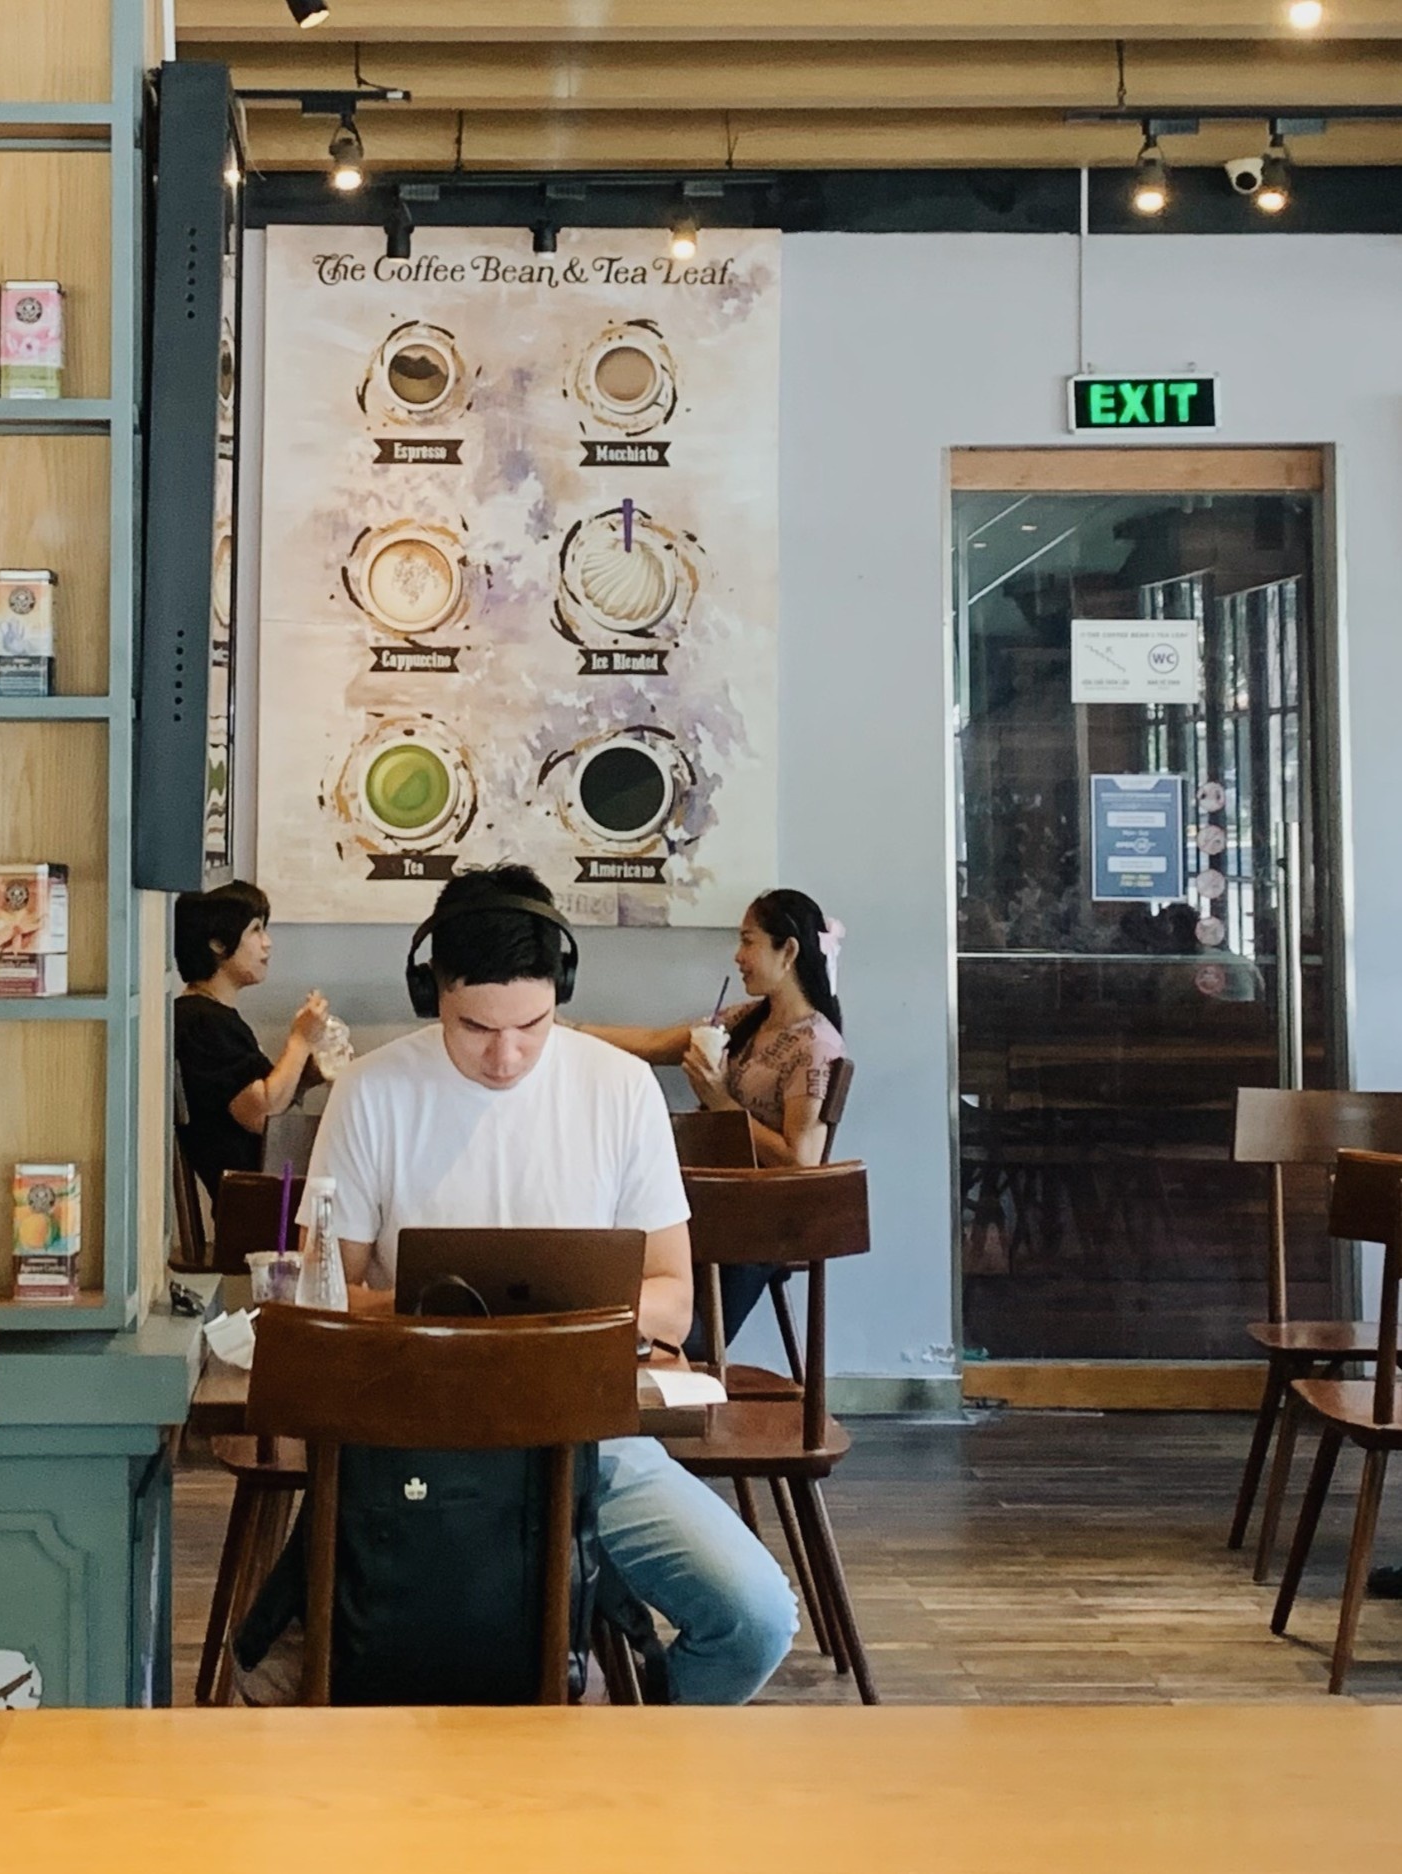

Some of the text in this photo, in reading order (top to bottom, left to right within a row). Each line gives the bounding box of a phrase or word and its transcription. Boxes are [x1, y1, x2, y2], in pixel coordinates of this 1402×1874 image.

[313, 254, 365, 285] The
[374, 255, 465, 282] Coffee
[471, 256, 559, 288] Bean
[562, 257, 588, 283] &
[592, 257, 646, 284] Tea
[1090, 382, 1198, 424] EXIT
[394, 442, 447, 463] Espresso
[596, 445, 659, 462] Macchiato
[381, 650, 452, 671] Cappuccino
[591, 653, 658, 670] Ice Blended
[1152, 653, 1175, 664] WC
[403, 859, 424, 876] Tea
[589, 860, 657, 878] Americano
